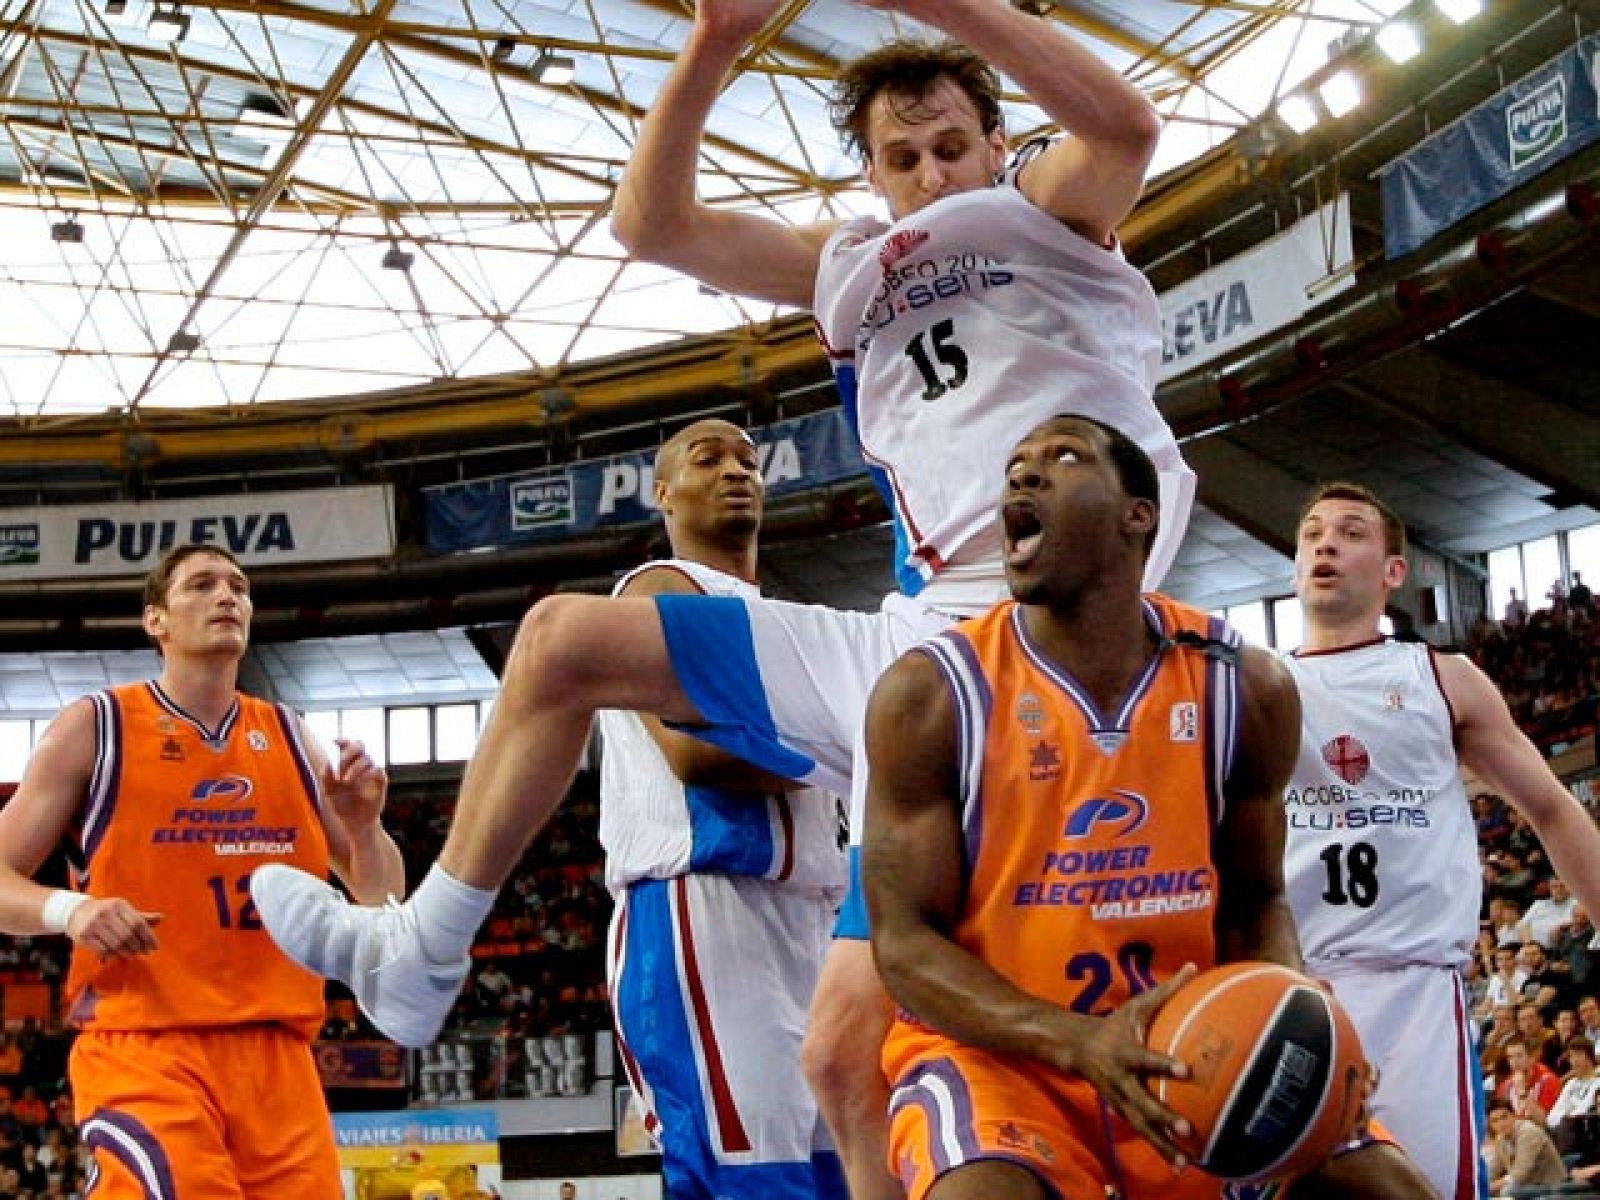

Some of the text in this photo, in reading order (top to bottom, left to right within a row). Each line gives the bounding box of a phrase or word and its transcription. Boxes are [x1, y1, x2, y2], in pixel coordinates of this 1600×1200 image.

[905, 318, 968, 400] 15
[75, 512, 295, 564] PULEVA
[1042, 845, 1151, 876] POWER
[1320, 842, 1379, 908] 18
